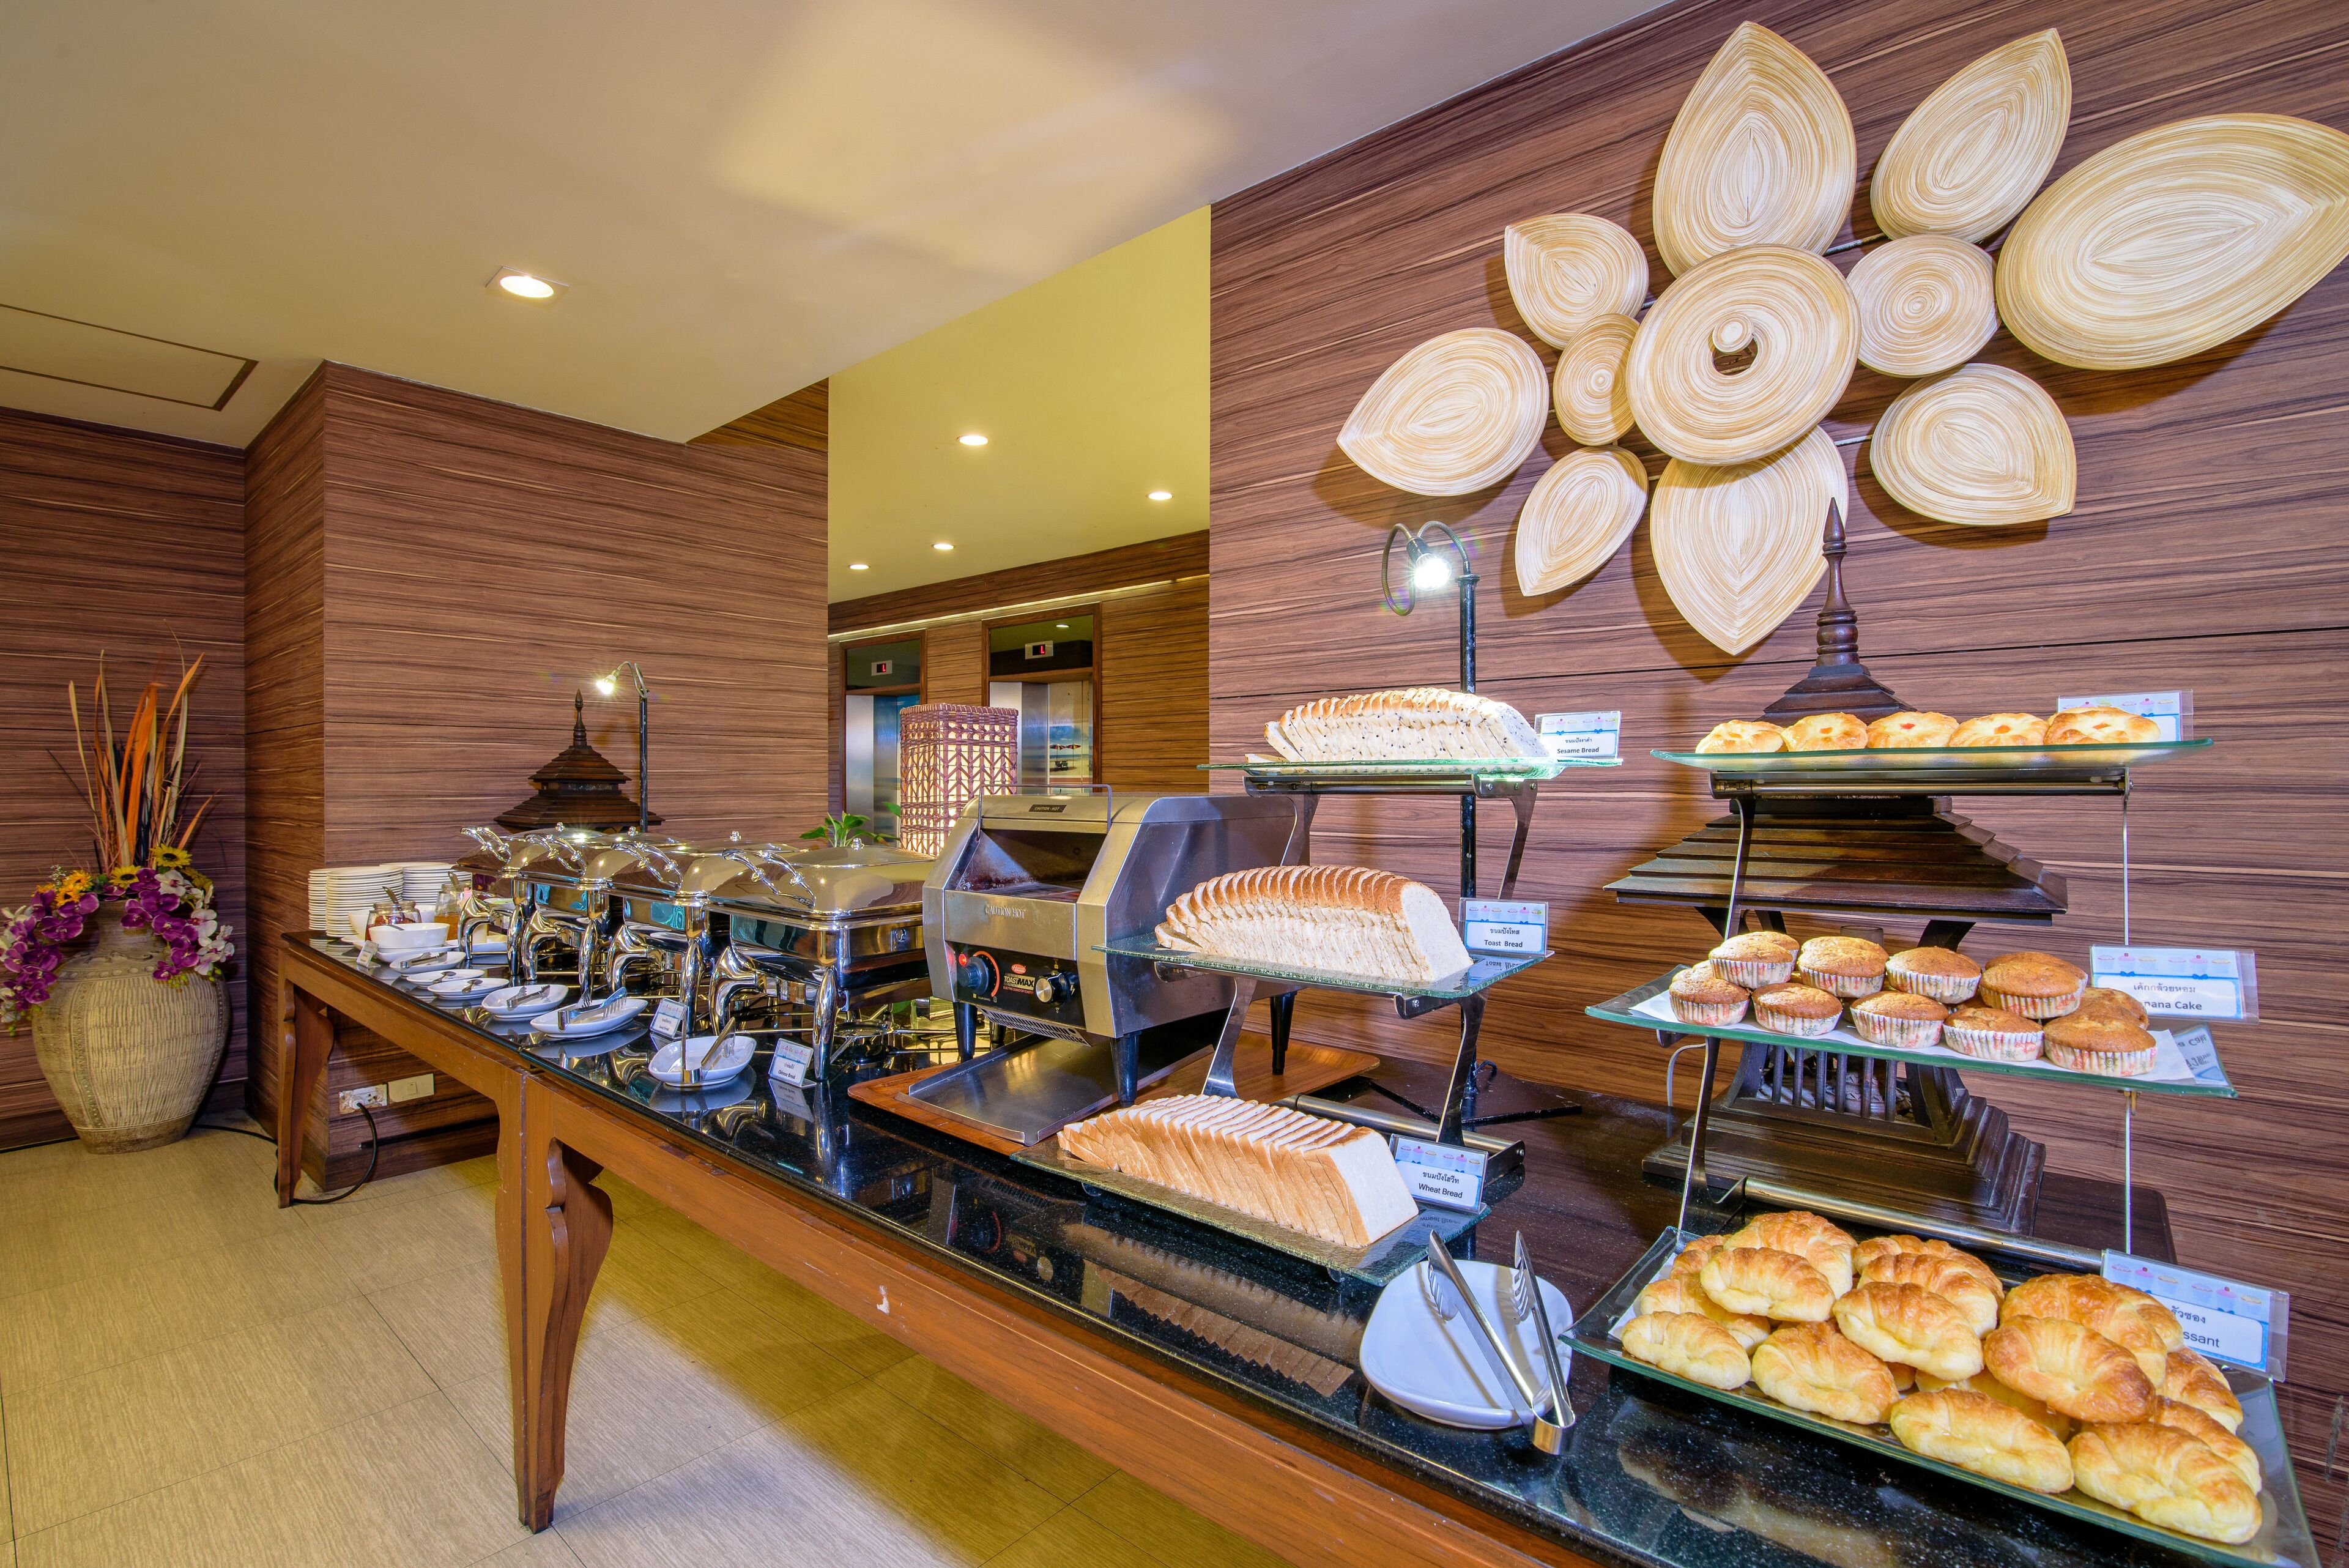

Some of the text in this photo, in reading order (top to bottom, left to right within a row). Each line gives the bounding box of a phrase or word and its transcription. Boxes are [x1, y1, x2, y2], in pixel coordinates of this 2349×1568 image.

[985, 905, 1026, 920] CAUTION HOT
[2175, 1001, 2202, 1010] Cake
[1418, 1183, 1463, 1198] Wheat Bread
[2171, 1305, 2206, 1324] รัวซอง
[2183, 1331, 2221, 1348] ssant
